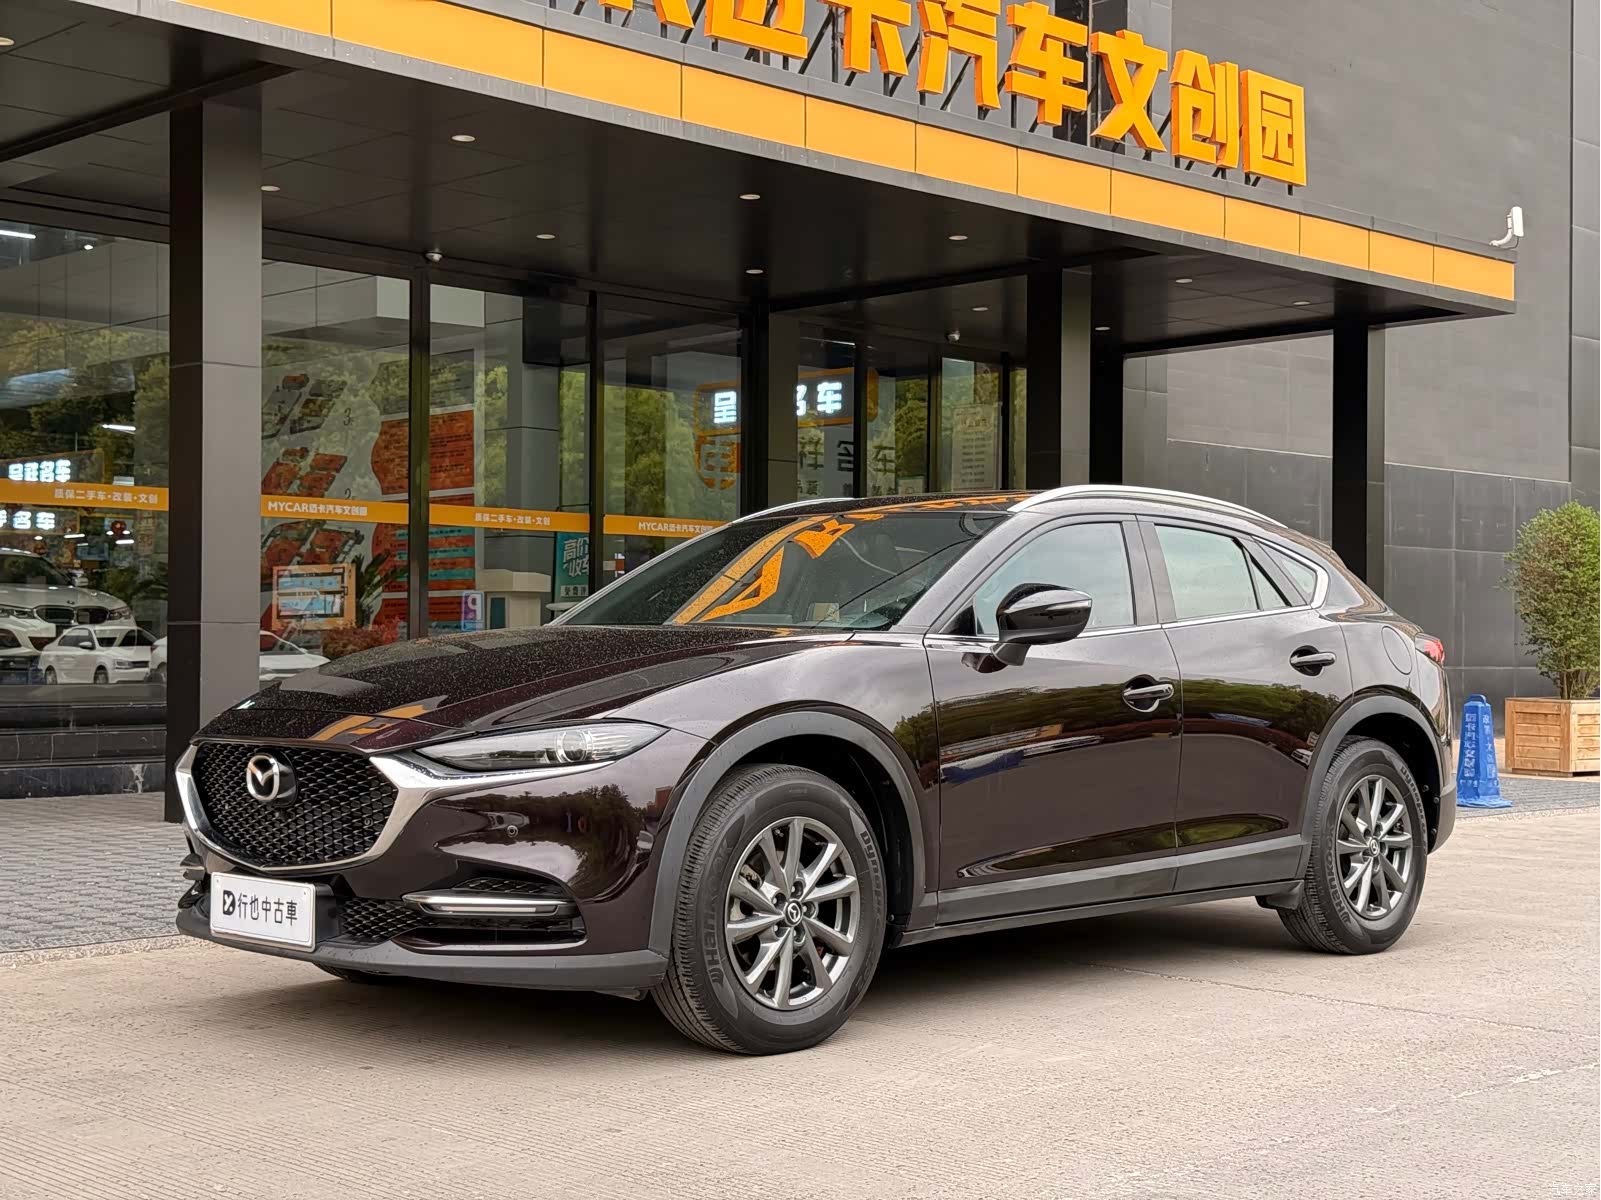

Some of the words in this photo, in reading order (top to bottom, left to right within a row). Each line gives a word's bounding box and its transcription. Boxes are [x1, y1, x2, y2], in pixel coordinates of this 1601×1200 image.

[237, 893, 298, 927] 行也中古車
